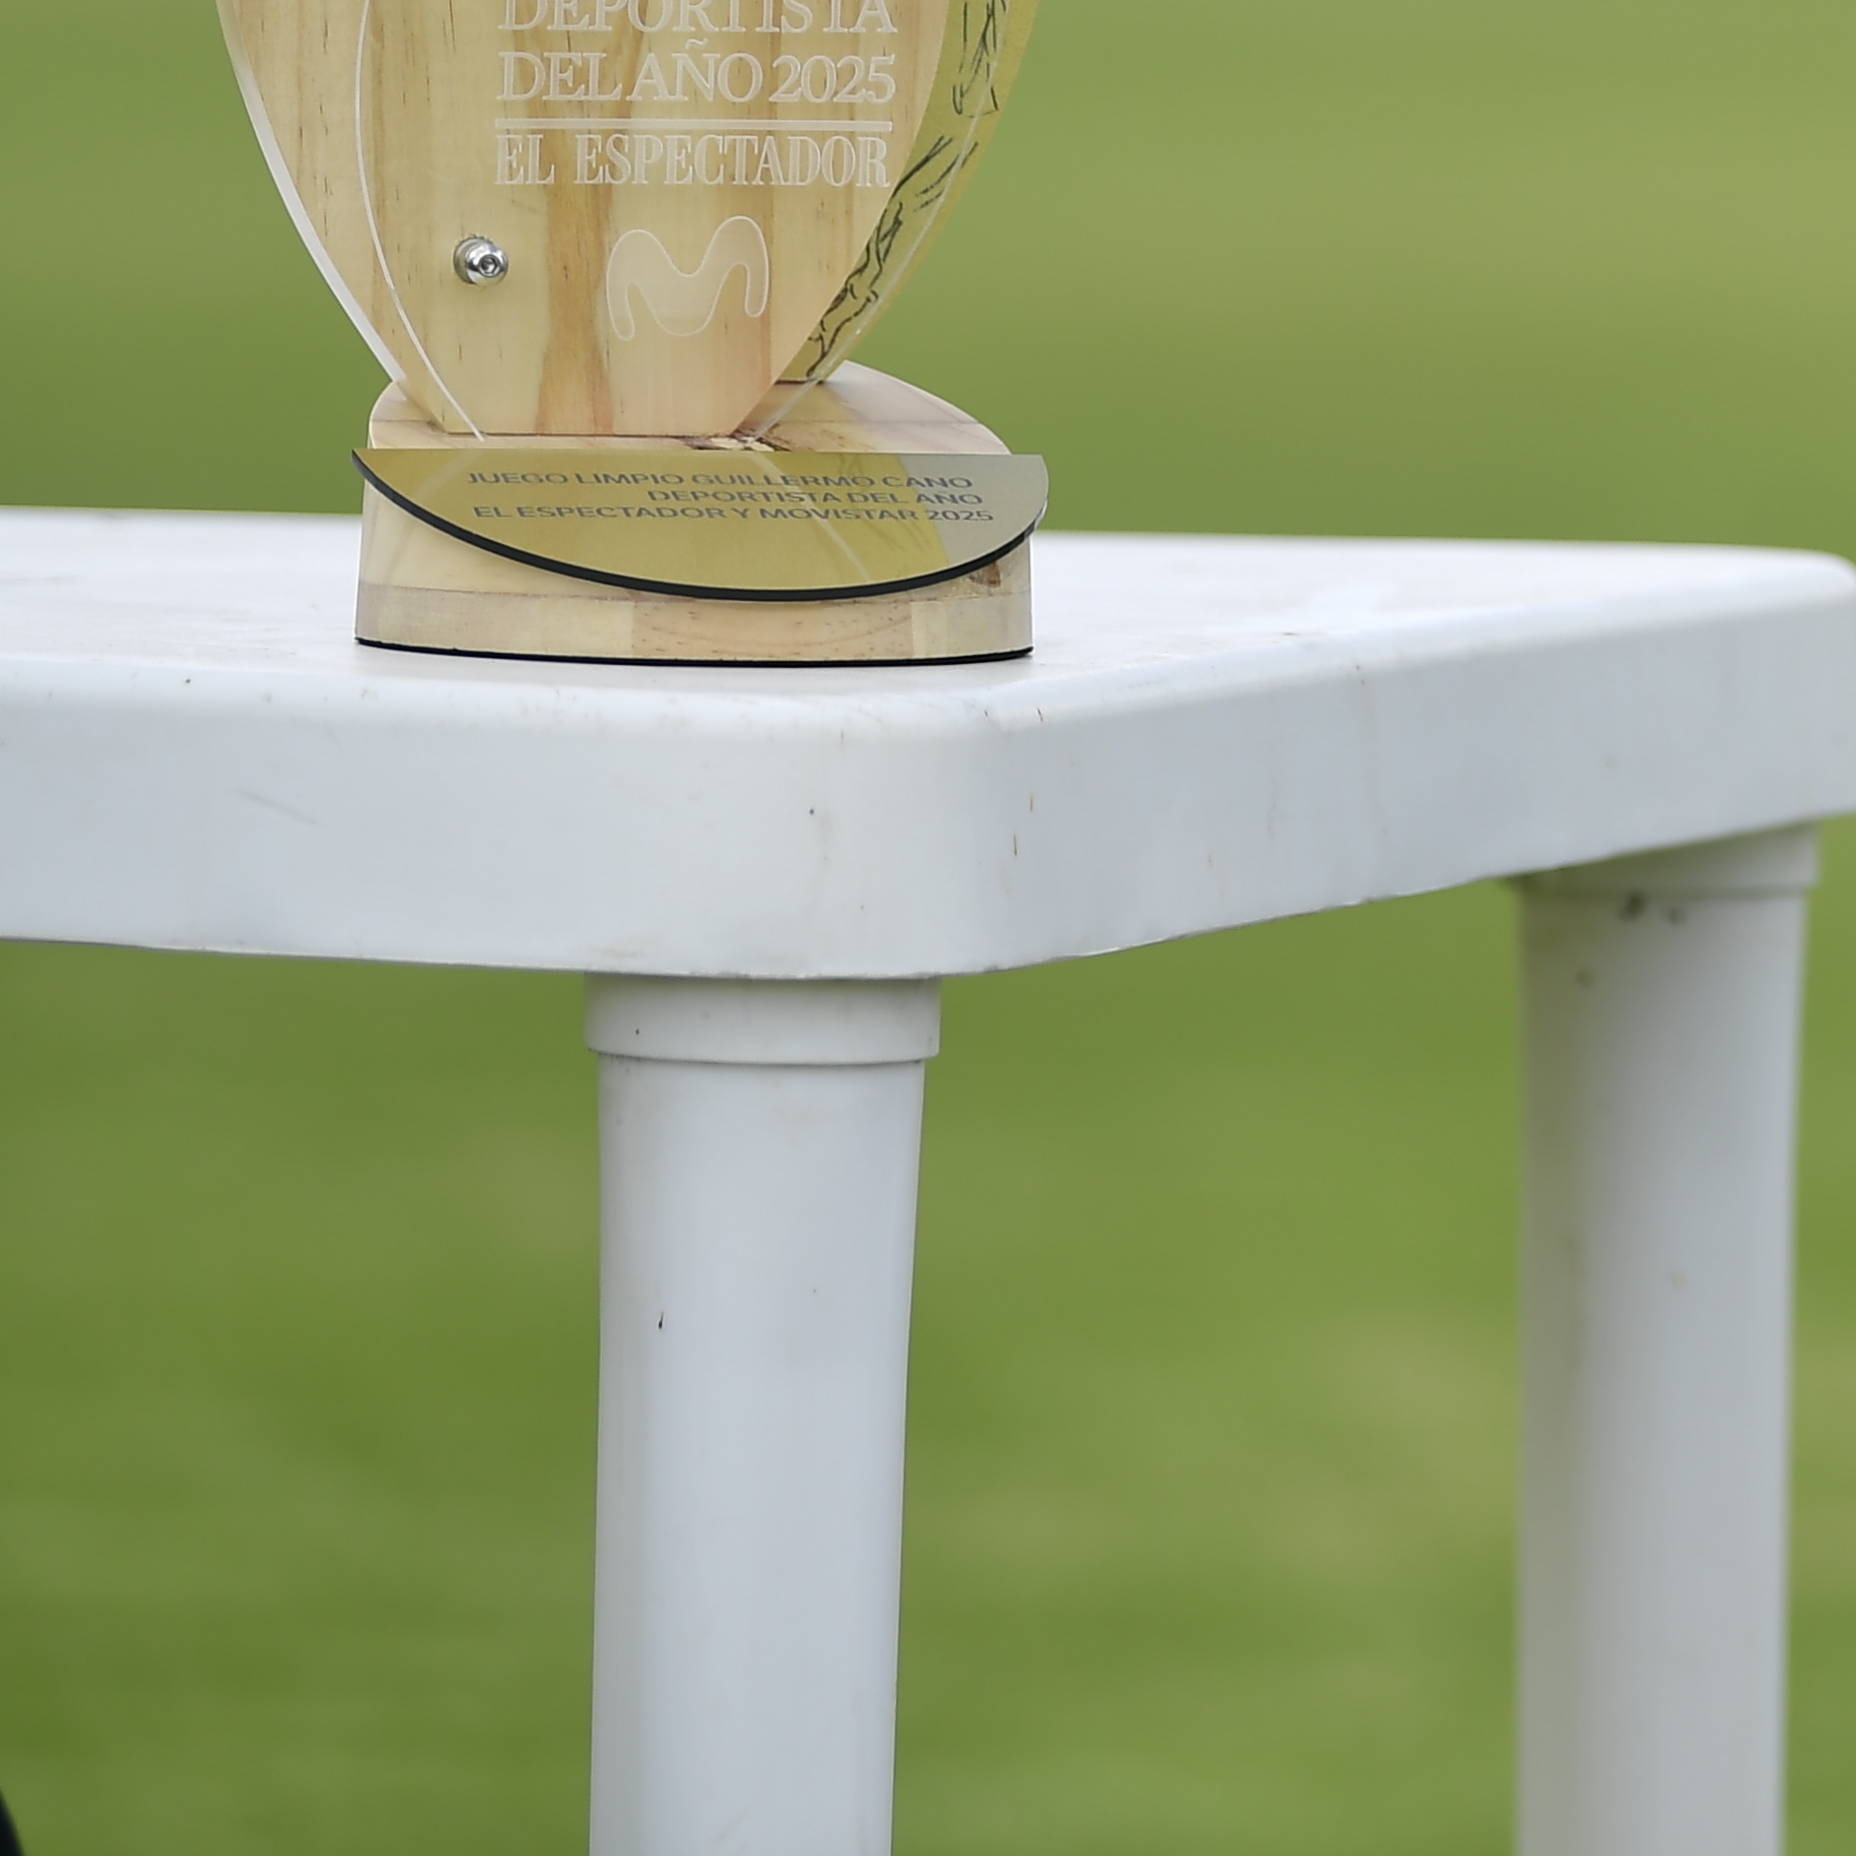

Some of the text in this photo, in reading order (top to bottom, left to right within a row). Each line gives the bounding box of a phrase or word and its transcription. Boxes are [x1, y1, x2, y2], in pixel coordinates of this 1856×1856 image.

[496, 37, 896, 104] DEL AÑO 2025
[494, 134, 891, 188] EL ESPECTADOR
[468, 471, 973, 490] JUEGO LIMPIO GUILLERMO CANO
[647, 489, 983, 506] DEPORTISTA DEL AÑO
[472, 505, 994, 523] EL ESPECTADOR Y MOVISTAR 2025
